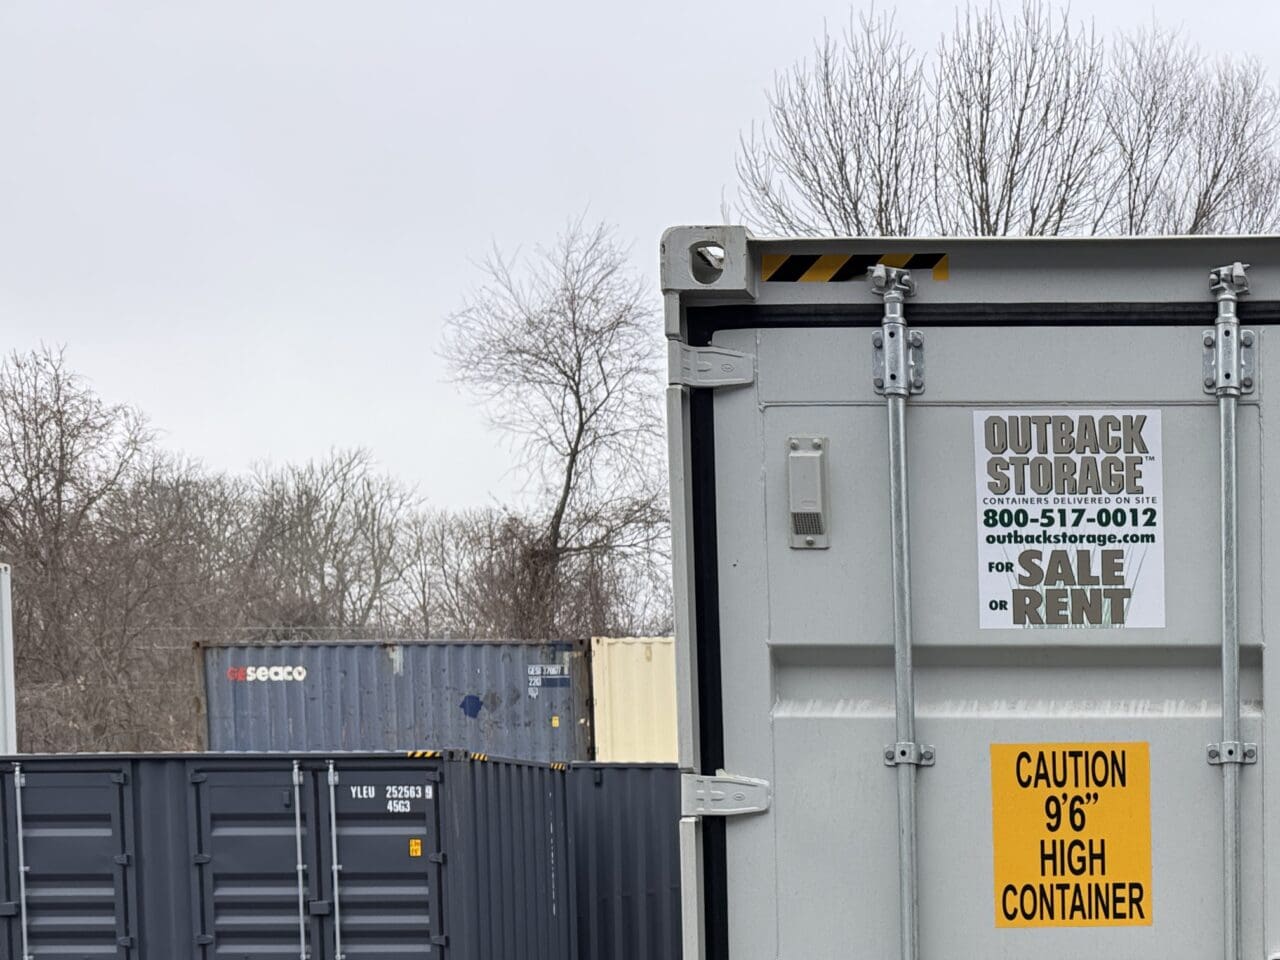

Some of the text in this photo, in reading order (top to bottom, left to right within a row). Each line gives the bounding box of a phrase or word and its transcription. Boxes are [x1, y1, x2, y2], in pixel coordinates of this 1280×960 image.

[984, 415, 1149, 454] OUTBACK
[986, 455, 1145, 496] STORAGE
[983, 497, 1049, 505] CONTAINERS
[1053, 497, 1111, 505] DELIVERED
[1135, 496, 1158, 504] SITE
[983, 508, 1157, 528] 800-517-0012
[985, 530, 1155, 546] outbackstorage.com
[988, 549, 1125, 586] FOR SALE
[989, 588, 1132, 625] OR RENT
[1015, 750, 1127, 788] CAUTION
[350, 785, 433, 799] YLEU 252563 9
[387, 800, 411, 812] 45G3
[1040, 839, 1106, 876] HIGH
[1002, 882, 1145, 921] CONTAINER
